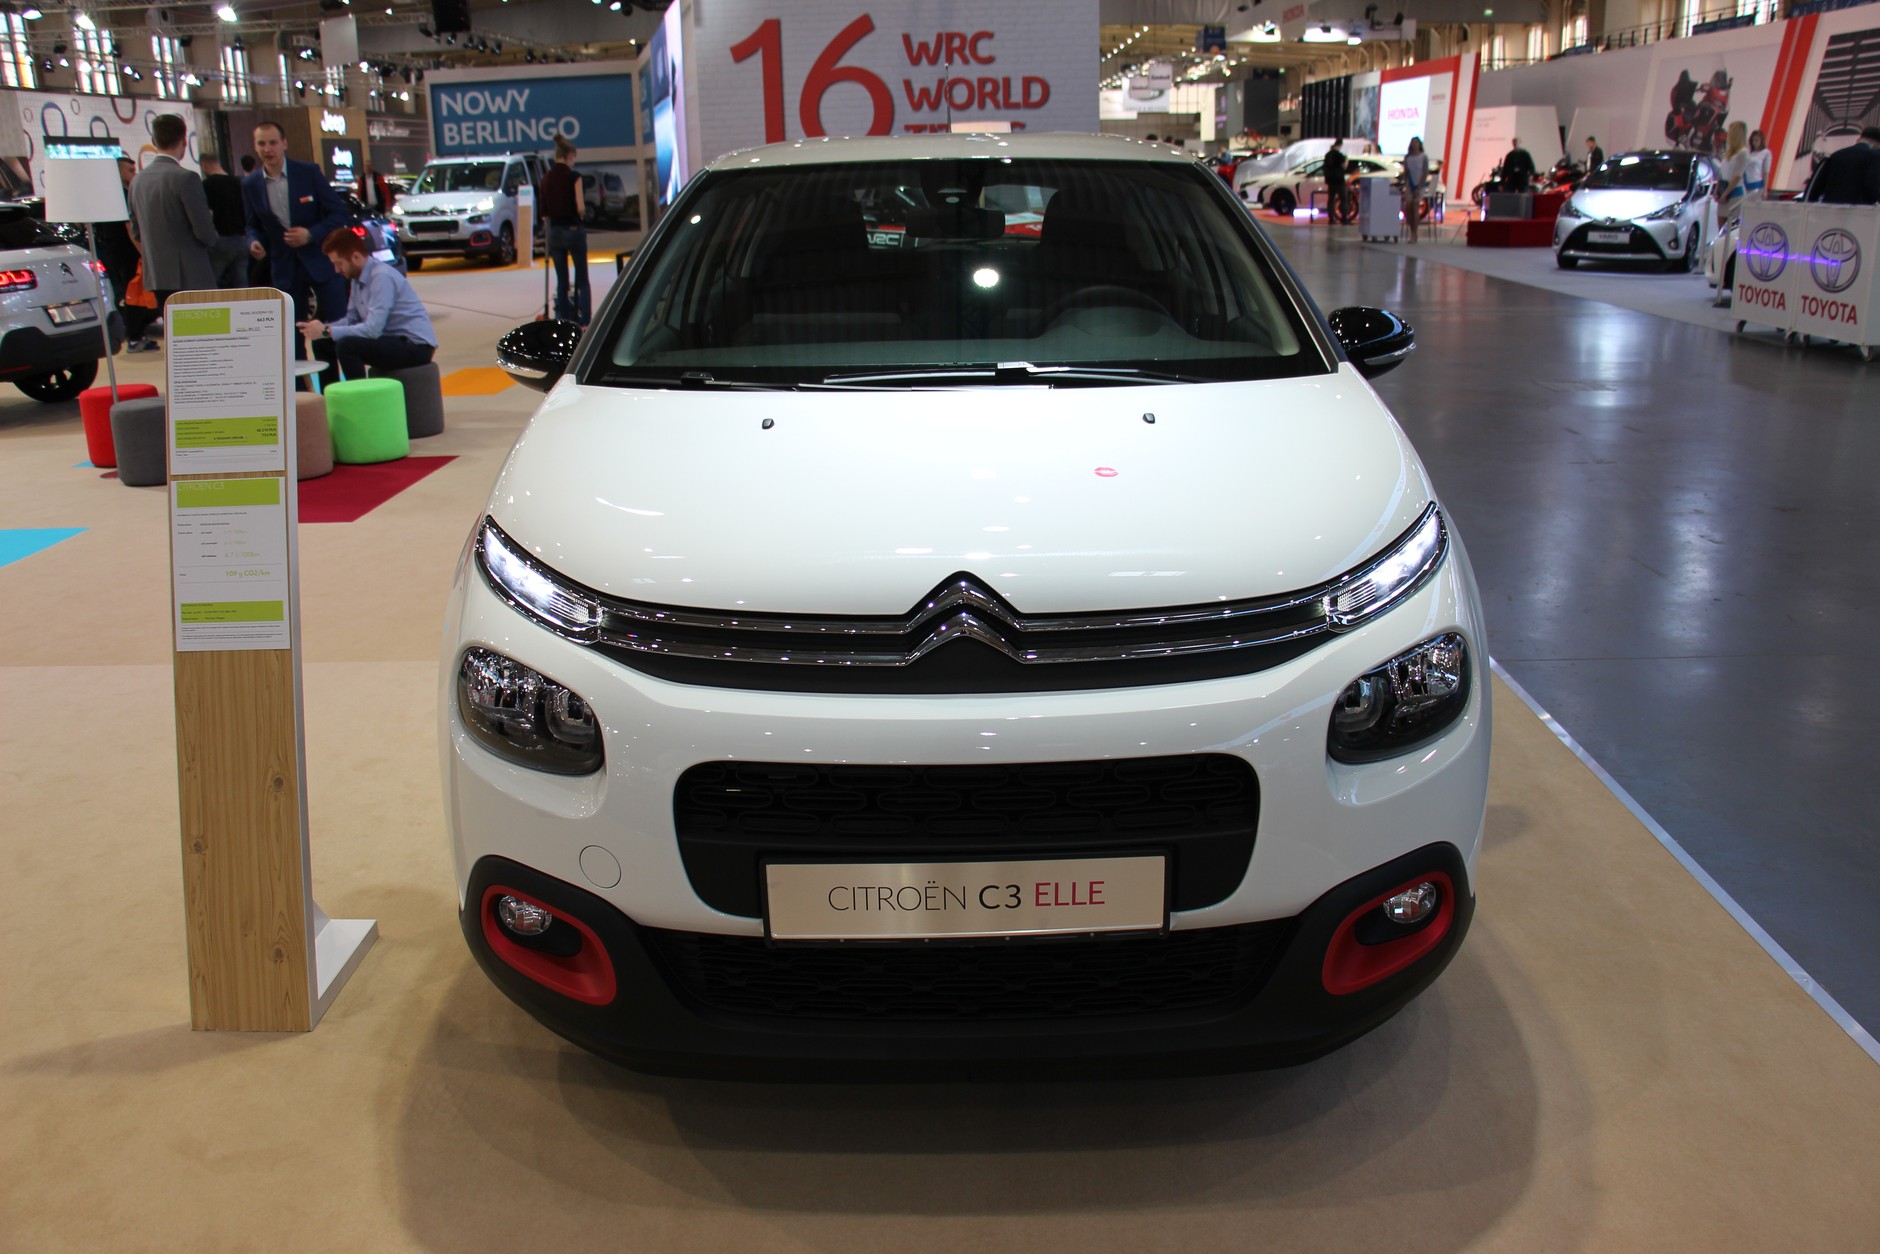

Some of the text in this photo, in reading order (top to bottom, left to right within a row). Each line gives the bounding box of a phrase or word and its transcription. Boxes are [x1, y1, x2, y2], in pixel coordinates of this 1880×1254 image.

[902, 31, 995, 66] WRC
[729, 12, 895, 144] 16
[440, 88, 530, 117] NOWY
[903, 76, 1050, 111] WORLD
[320, 109, 346, 136] Jeep
[1387, 107, 1419, 121] HONDA
[443, 116, 580, 146] BERLINGO
[1738, 284, 1786, 311] TOYOTA
[1801, 295, 1858, 325] TOYOTA
[828, 880, 1105, 911] CITROËN C3 ELLE
